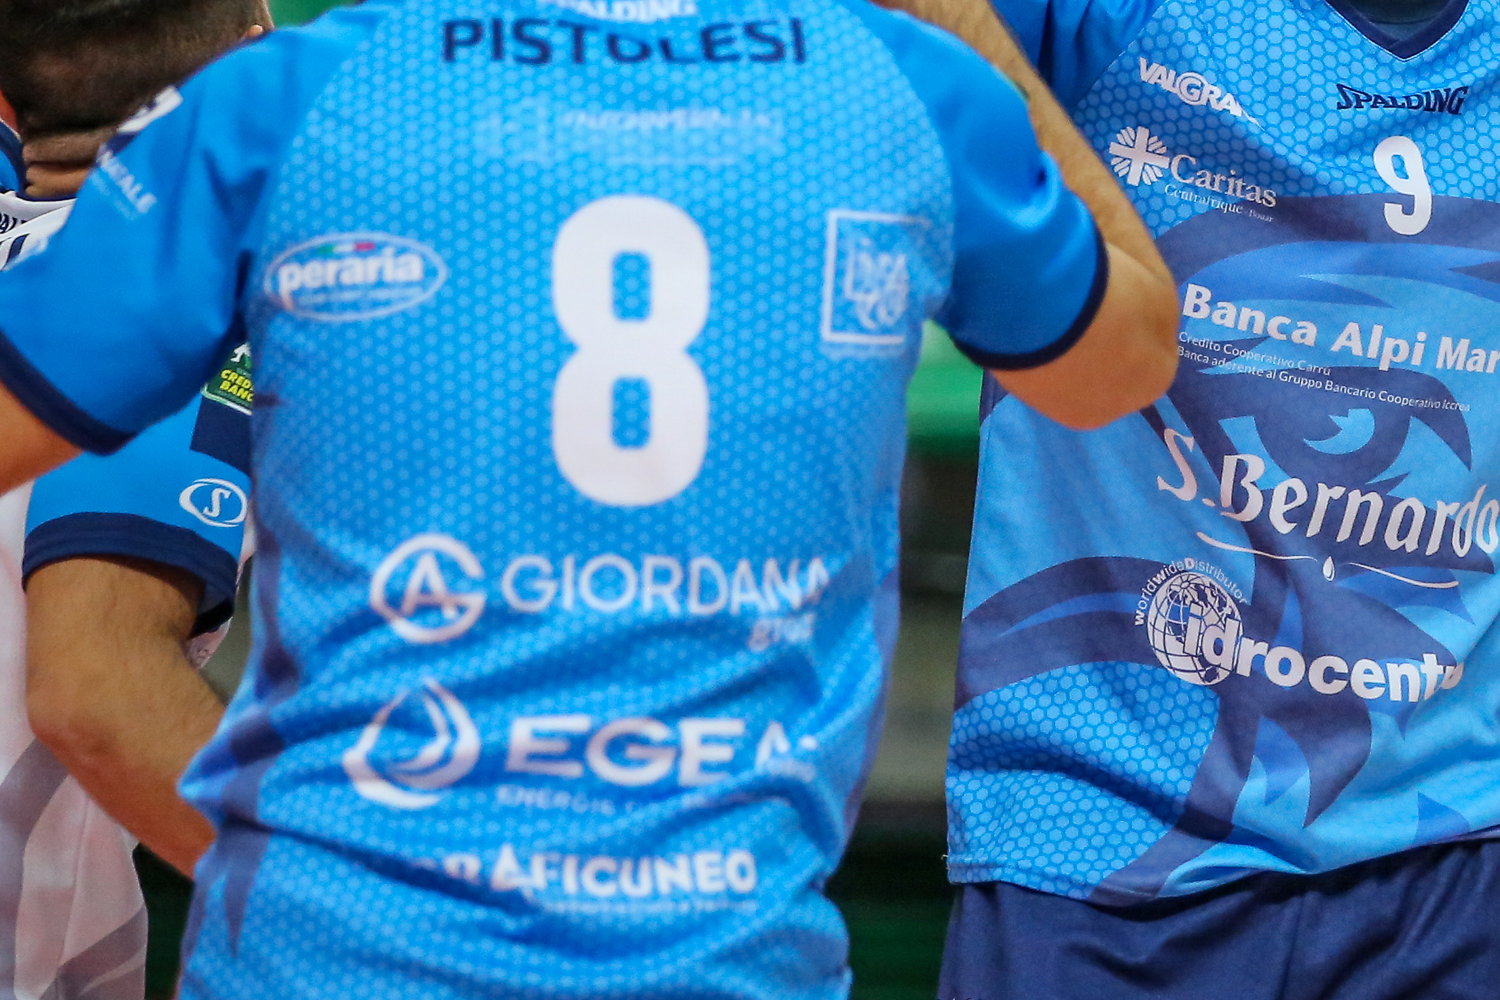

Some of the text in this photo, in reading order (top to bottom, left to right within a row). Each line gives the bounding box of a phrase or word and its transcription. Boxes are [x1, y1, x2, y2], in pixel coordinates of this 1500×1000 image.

[443, 17, 807, 65] PISTOLESI
[1138, 56, 1265, 131] VALGRA
[1336, 83, 1469, 116] SPALDING
[1170, 153, 1277, 208] Caritas
[1373, 135, 1433, 236] 9
[552, 195, 711, 507] 8
[1178, 331, 1221, 352] Credito
[1223, 344, 1295, 368] Cooperativo
[1182, 283, 1319, 347] Banca
[1330, 321, 1428, 372] Alpi
[1178, 346, 1209, 364] Banca
[1265, 369, 1277, 380] al
[1279, 371, 1323, 390] Gruppo
[1325, 380, 1376, 400] Bancario
